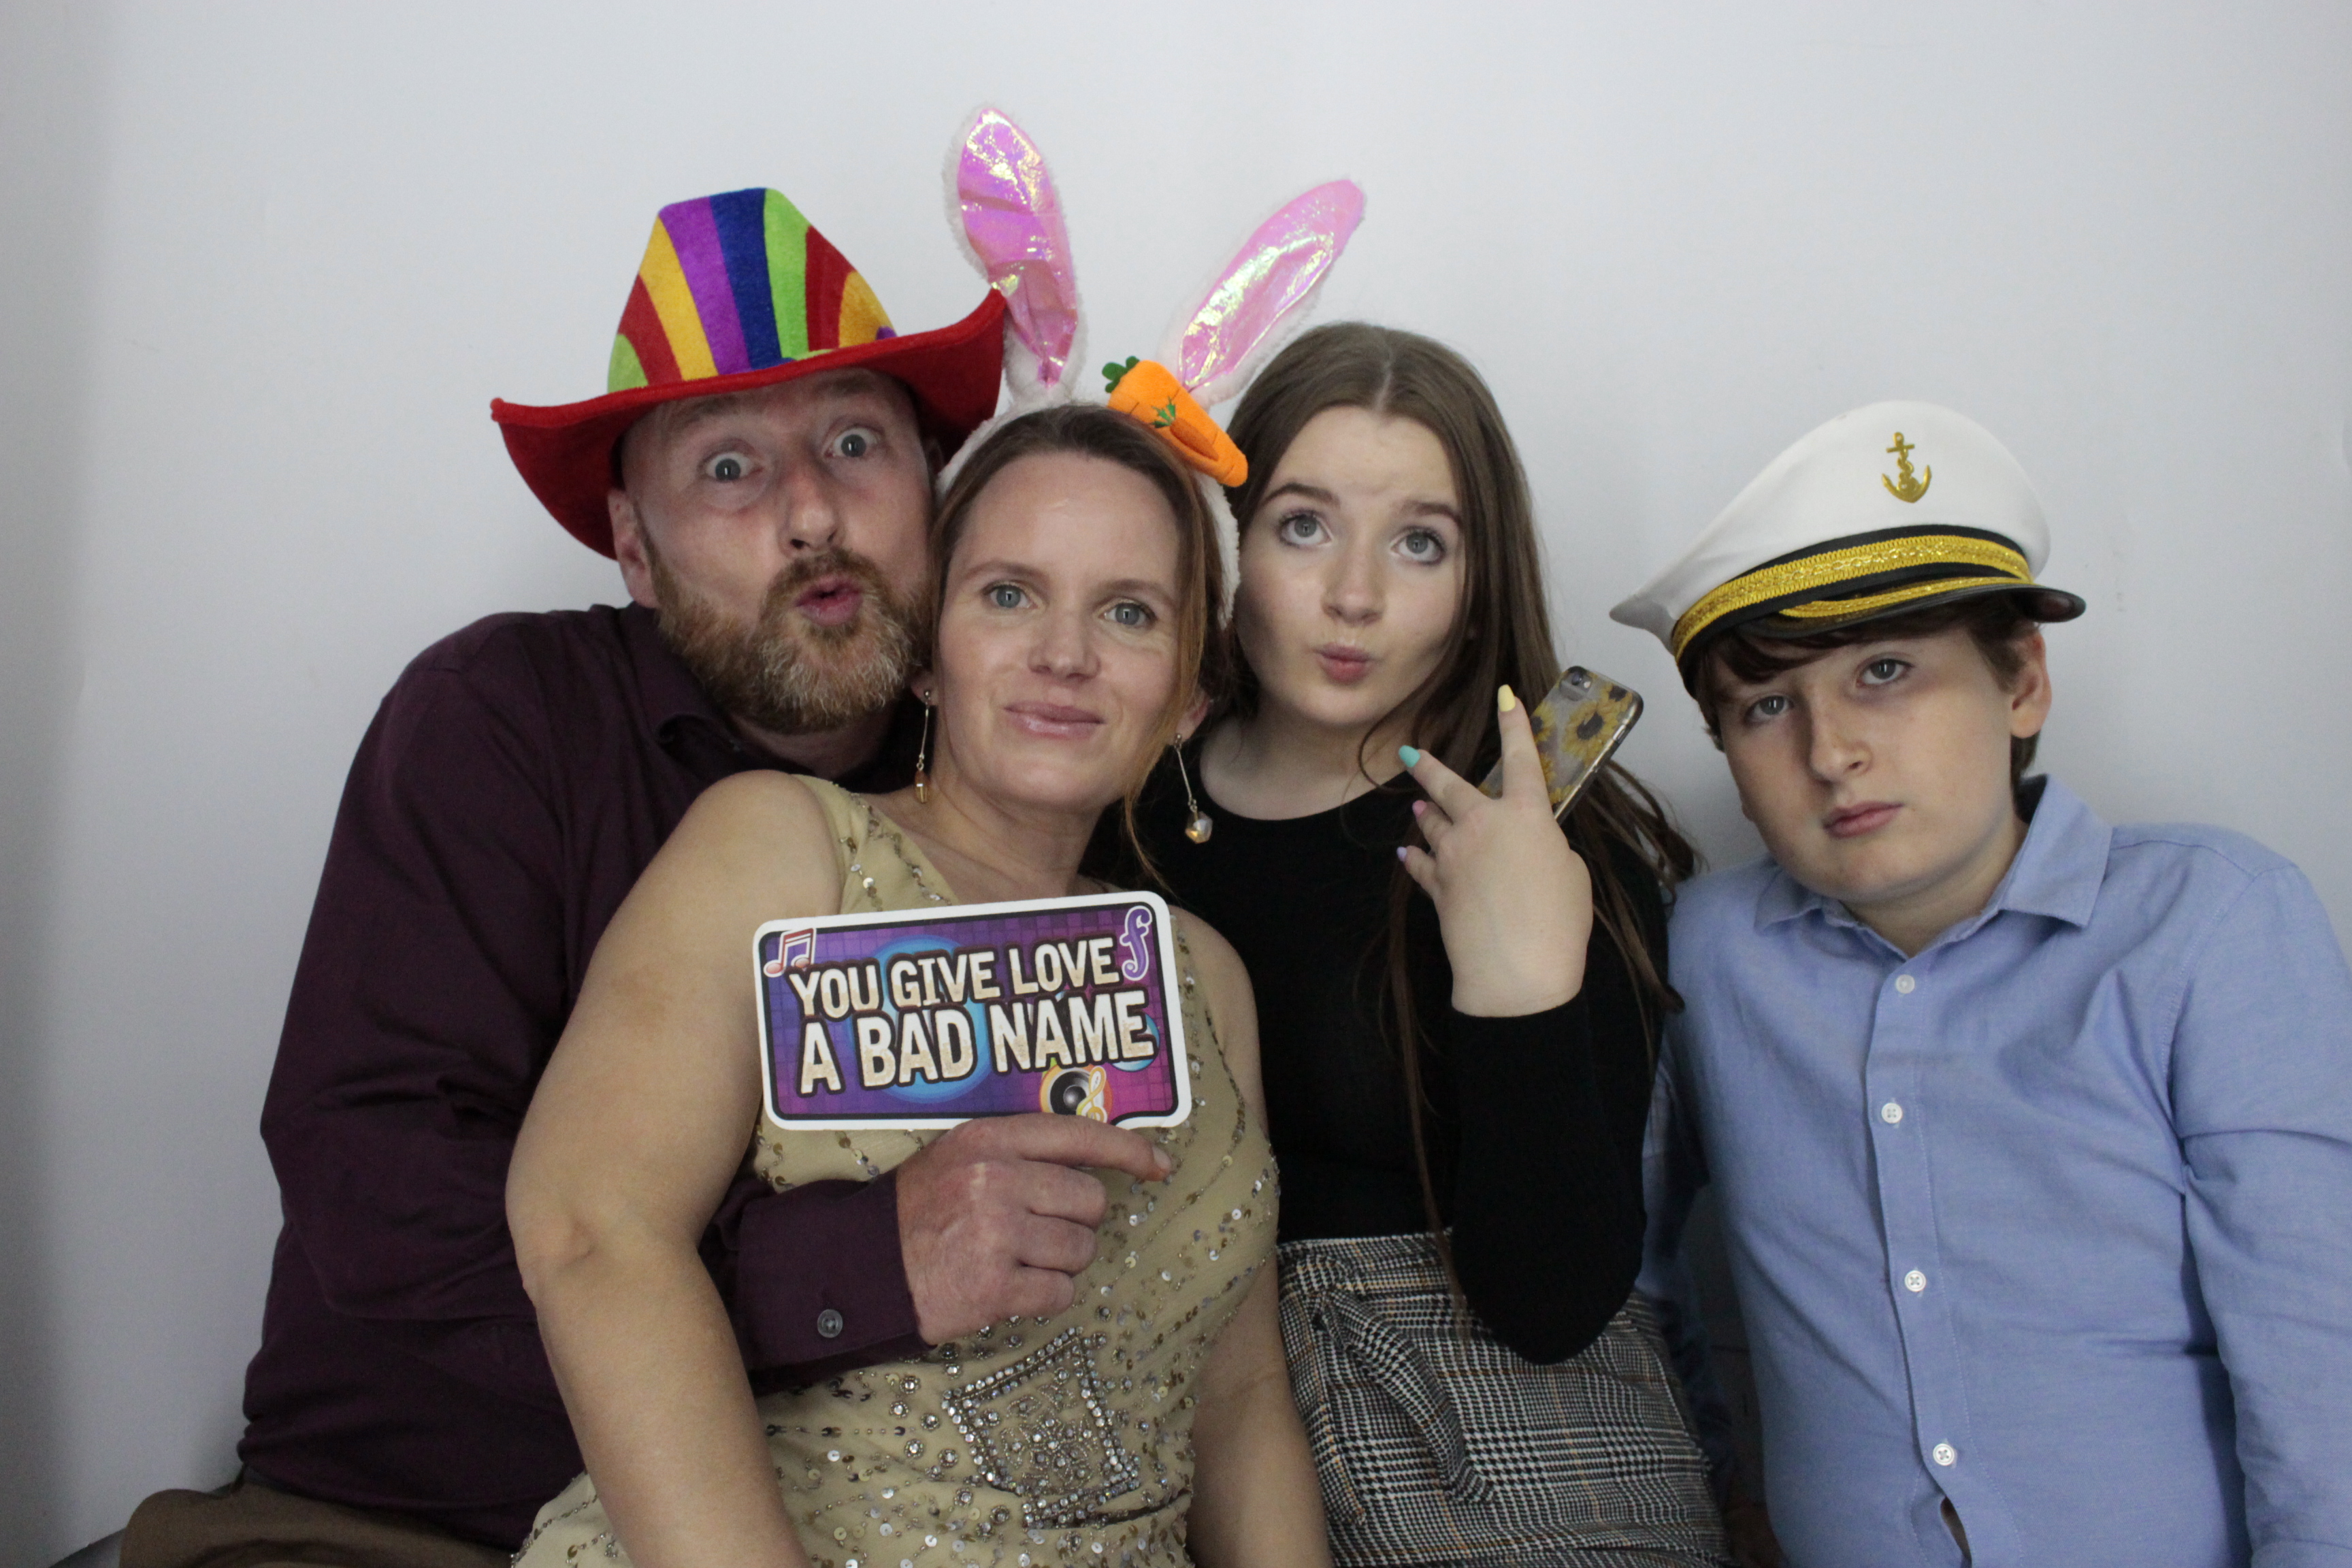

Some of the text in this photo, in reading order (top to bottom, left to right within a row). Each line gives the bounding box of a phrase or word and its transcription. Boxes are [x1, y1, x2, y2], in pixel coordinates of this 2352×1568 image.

[789, 936, 1120, 1018] YOU GIVE LOVE
[800, 991, 1154, 1094] A BAD NAME
